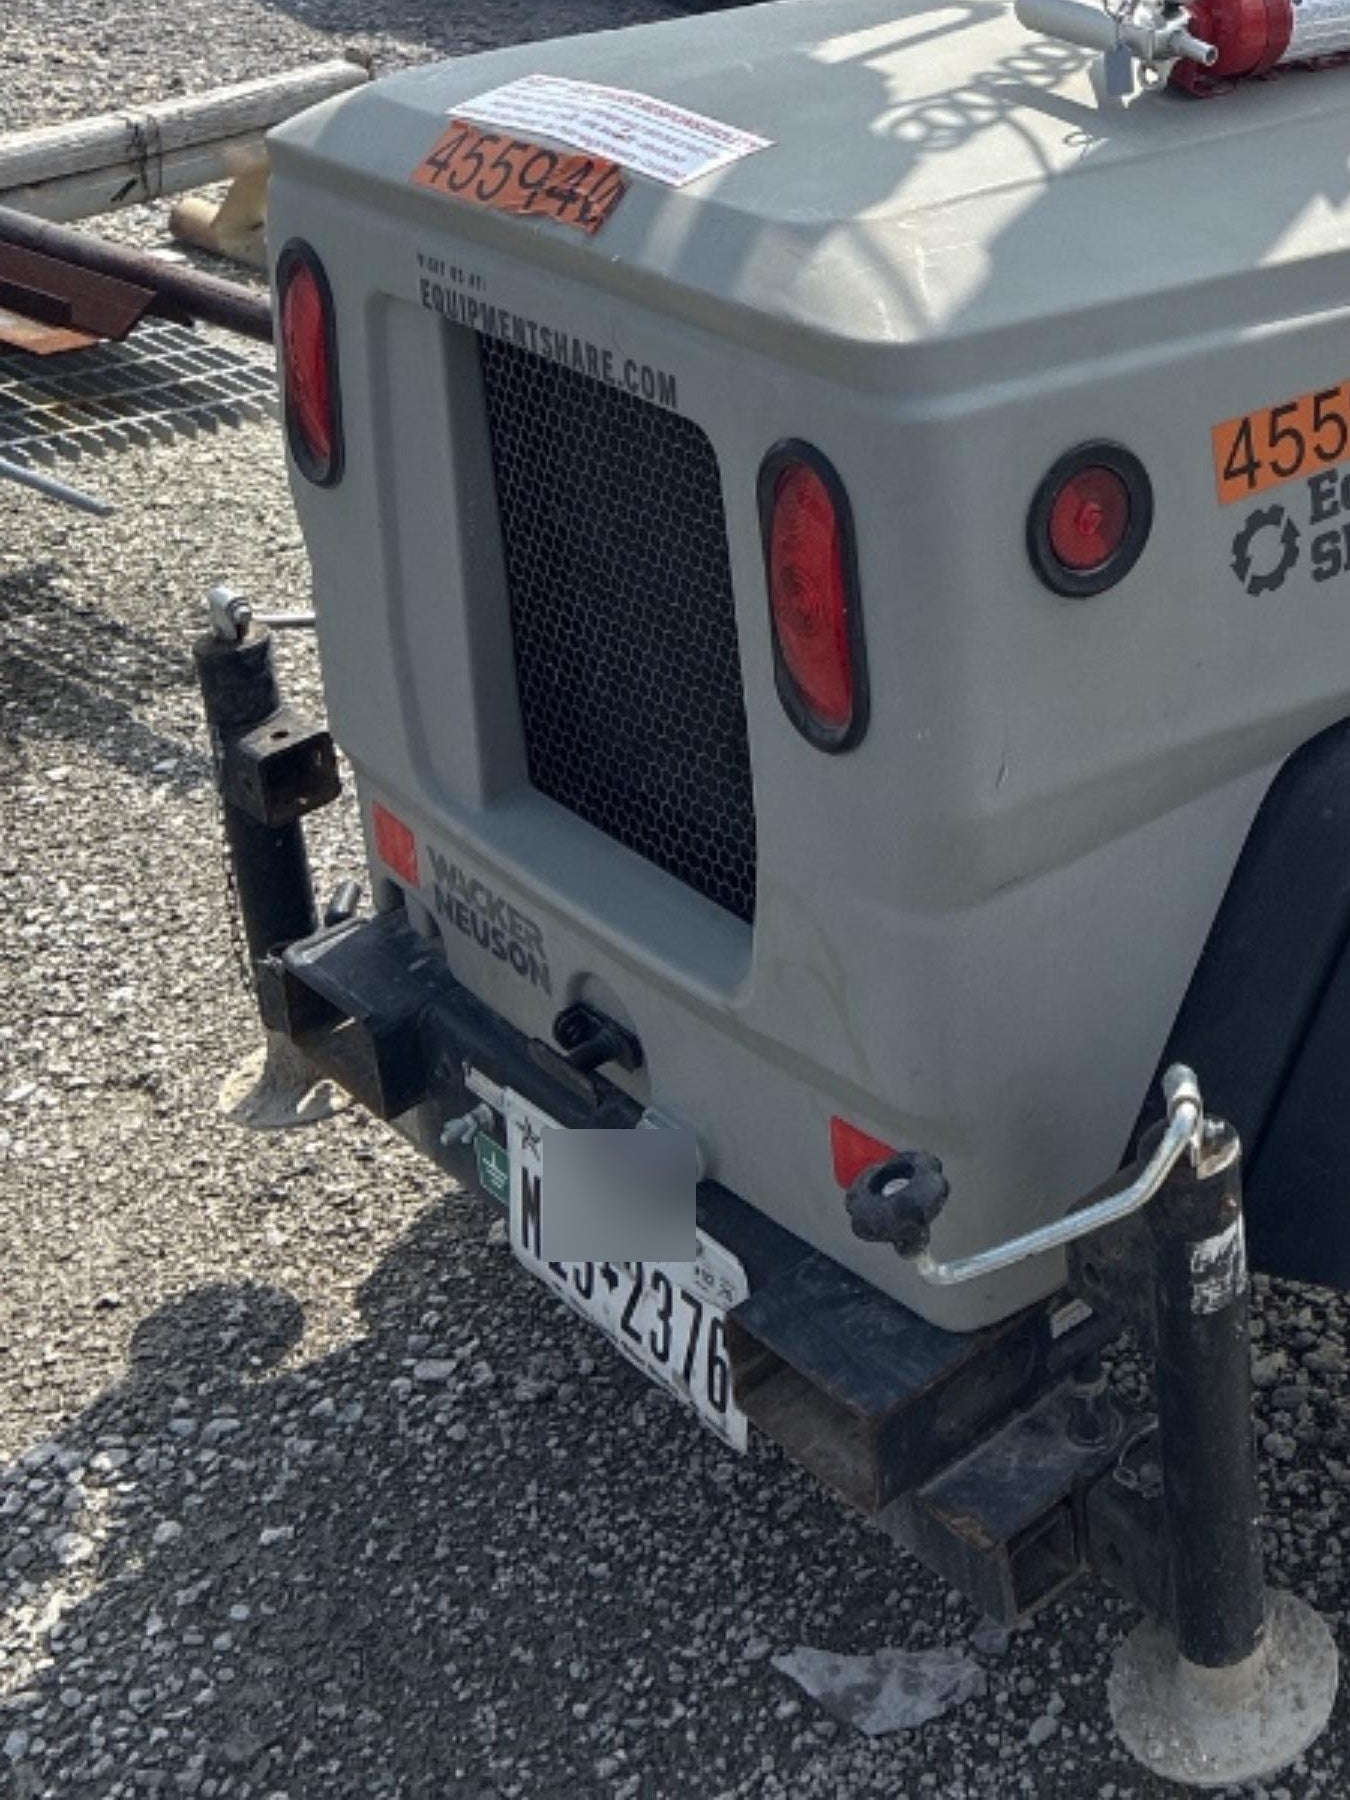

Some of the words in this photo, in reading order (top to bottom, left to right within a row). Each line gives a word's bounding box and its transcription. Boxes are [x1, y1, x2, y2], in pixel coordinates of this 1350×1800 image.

[420, 278, 679, 408] EQUIPMENTSHARE.COM
[426, 845, 547, 960] WACKER
[434, 881, 553, 998] NEUSON
